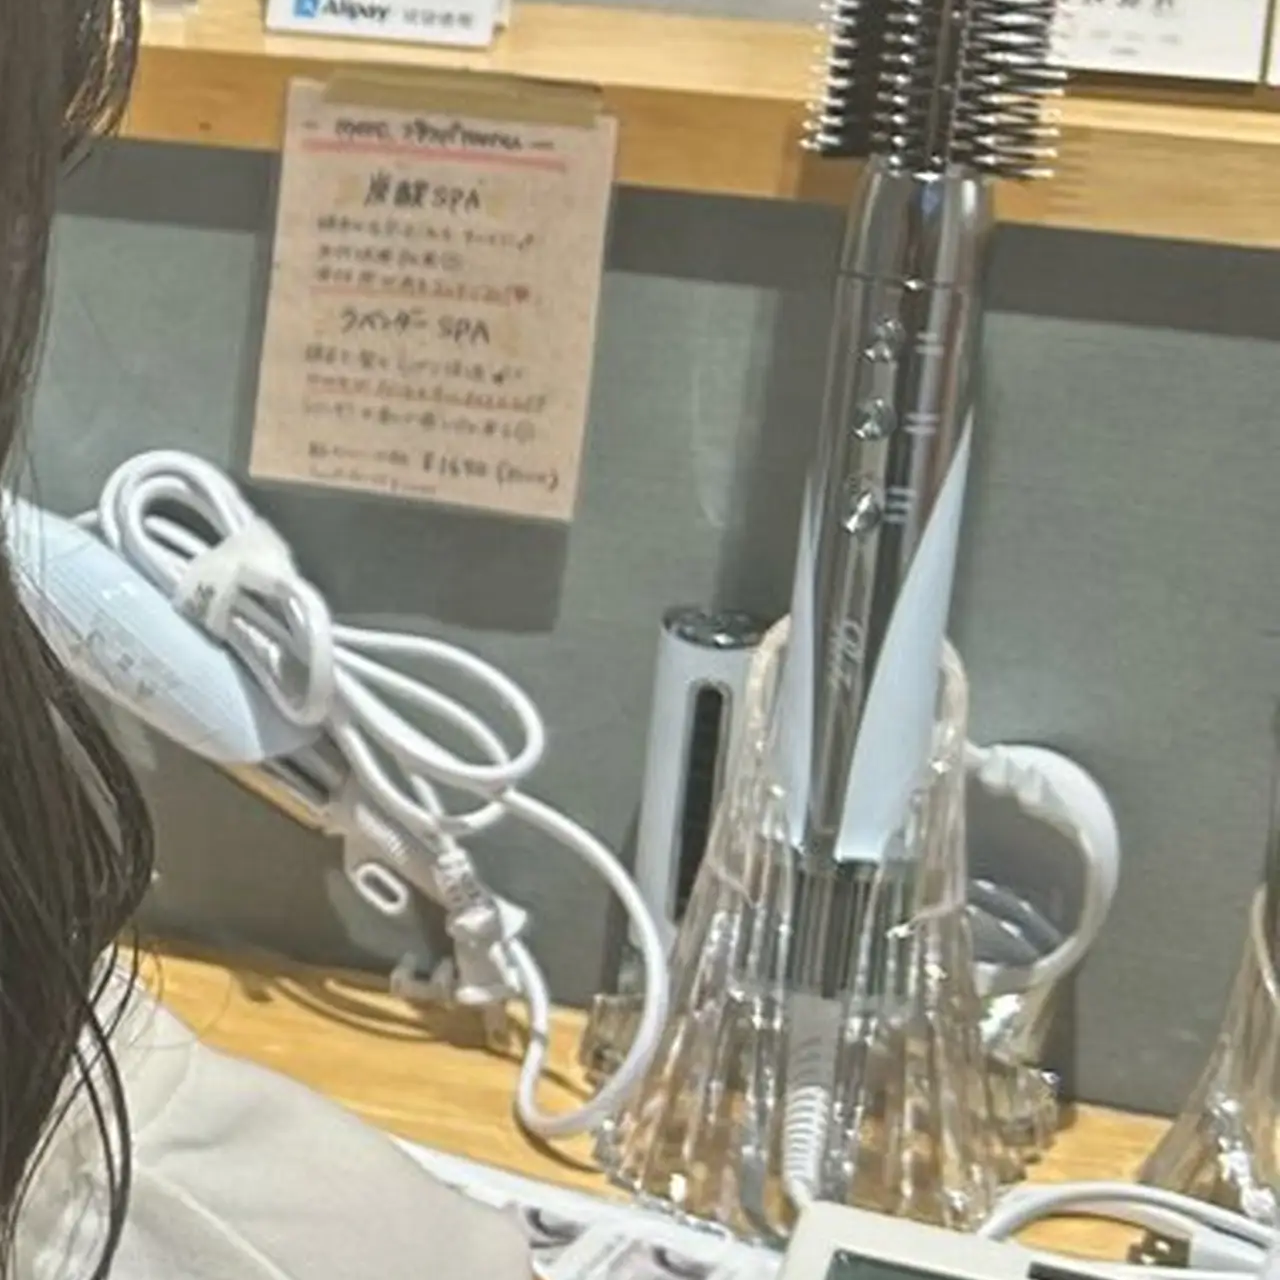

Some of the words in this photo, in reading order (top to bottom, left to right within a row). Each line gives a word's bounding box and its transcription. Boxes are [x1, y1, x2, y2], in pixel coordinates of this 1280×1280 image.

[341, 305, 428, 335] ラベンダー
[438, 315, 491, 346] SPA
